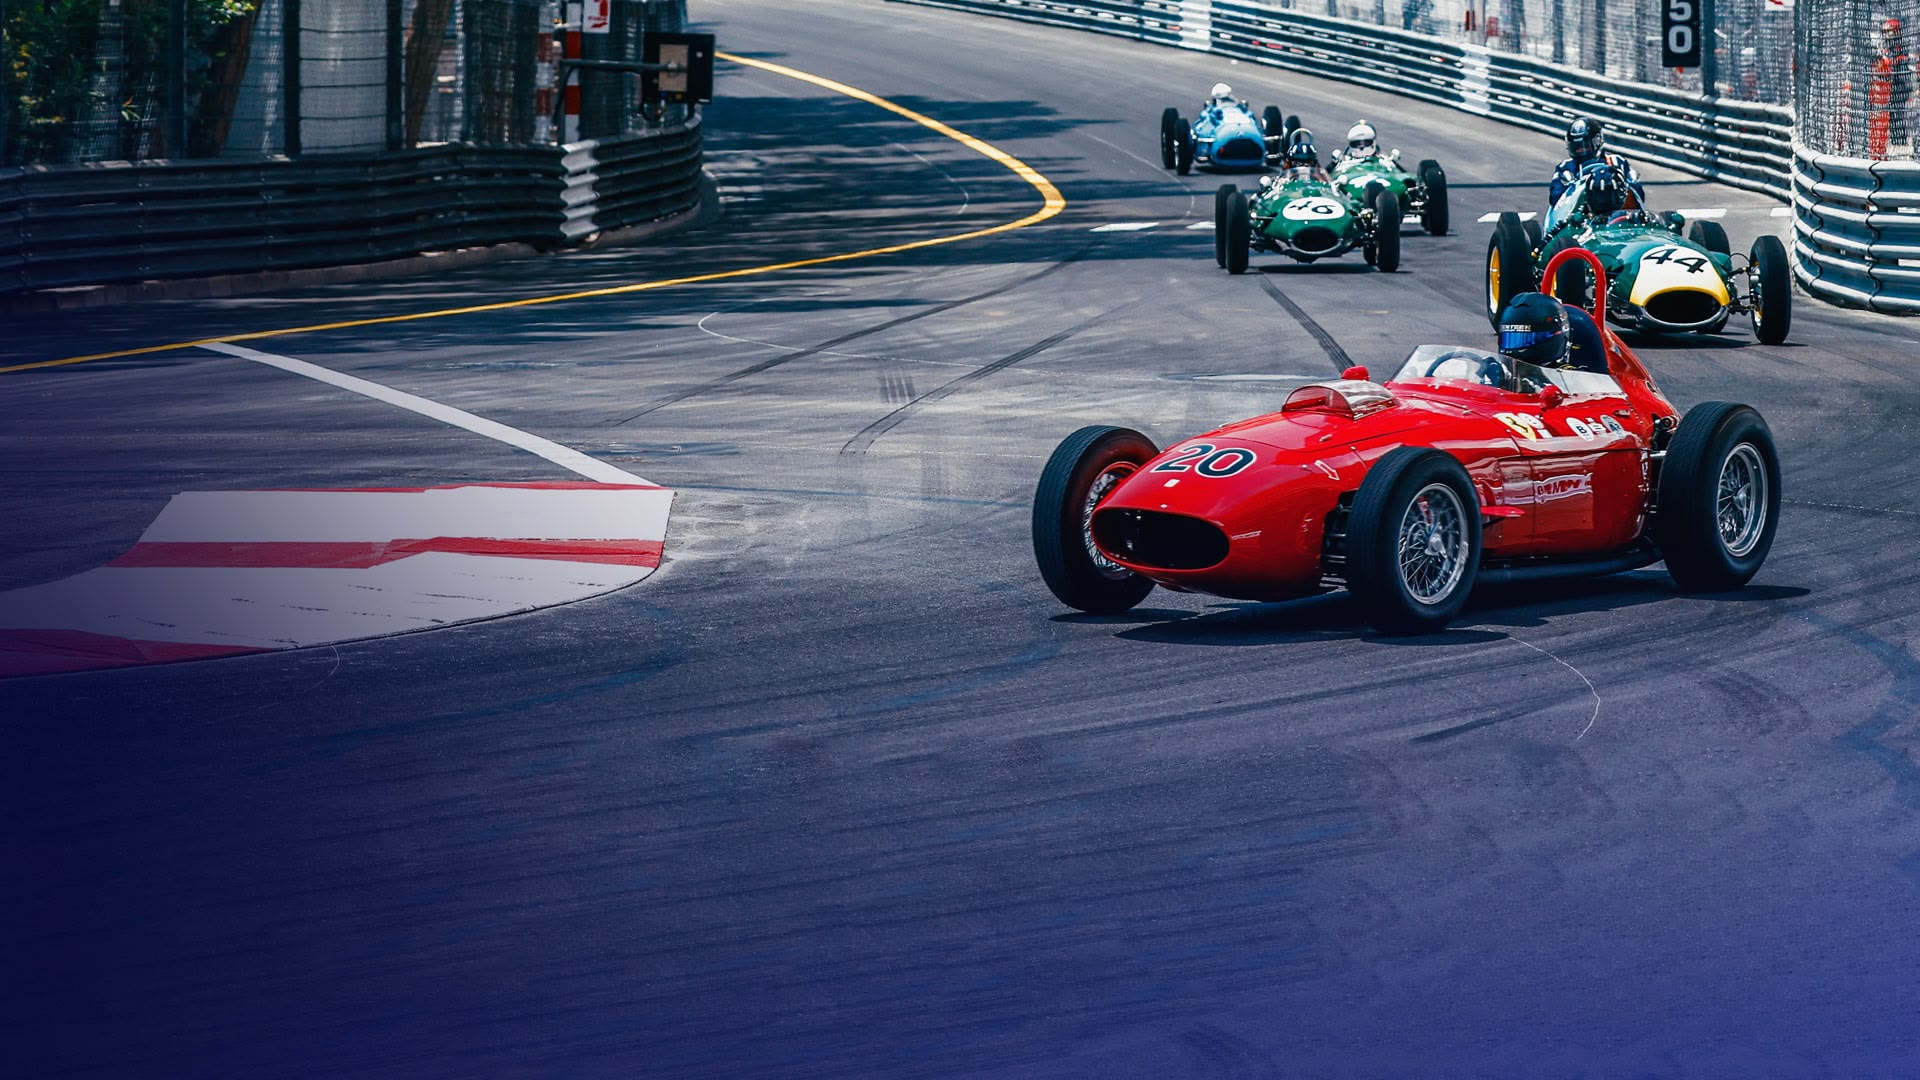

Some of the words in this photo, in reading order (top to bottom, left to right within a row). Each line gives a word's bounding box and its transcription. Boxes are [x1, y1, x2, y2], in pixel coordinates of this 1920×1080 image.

[1289, 200, 1335, 214] 46
[1643, 248, 1708, 274] 44
[1150, 443, 1257, 478] 20
